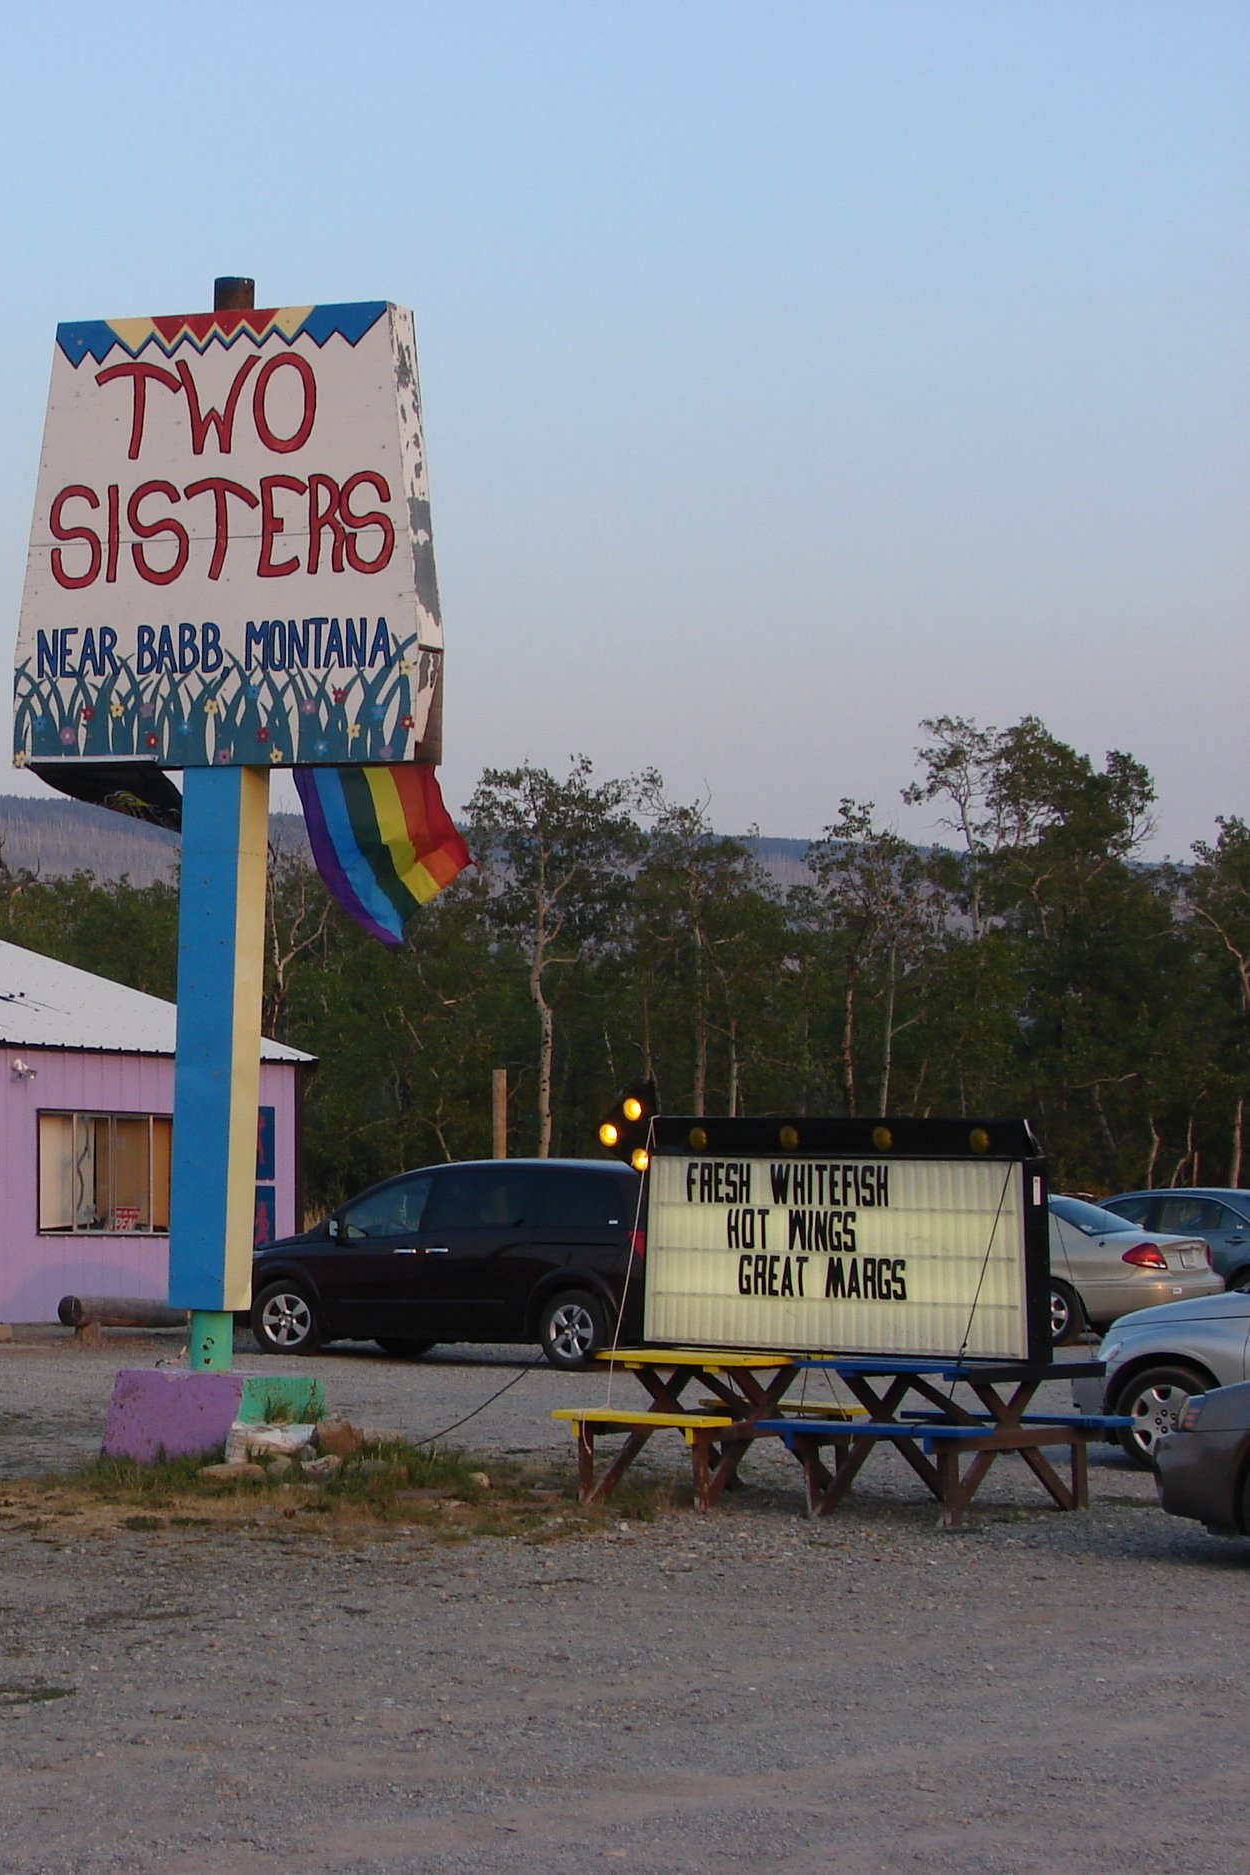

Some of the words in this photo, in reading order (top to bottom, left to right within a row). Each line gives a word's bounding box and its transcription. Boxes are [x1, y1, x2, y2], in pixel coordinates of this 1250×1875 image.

[95, 351, 317, 460] TWO
[49, 470, 395, 590] SISTERS
[36, 626, 120, 679] NEAR
[137, 622, 230, 680] BABB,
[245, 617, 393, 672] MONTANA
[686, 1162, 751, 1204] FRESH
[770, 1163, 889, 1207] WHITEFISH
[727, 1208, 770, 1250] HOT
[788, 1209, 857, 1253] WINGS
[738, 1254, 809, 1298] GREAT
[825, 1257, 907, 1301] MARGS
